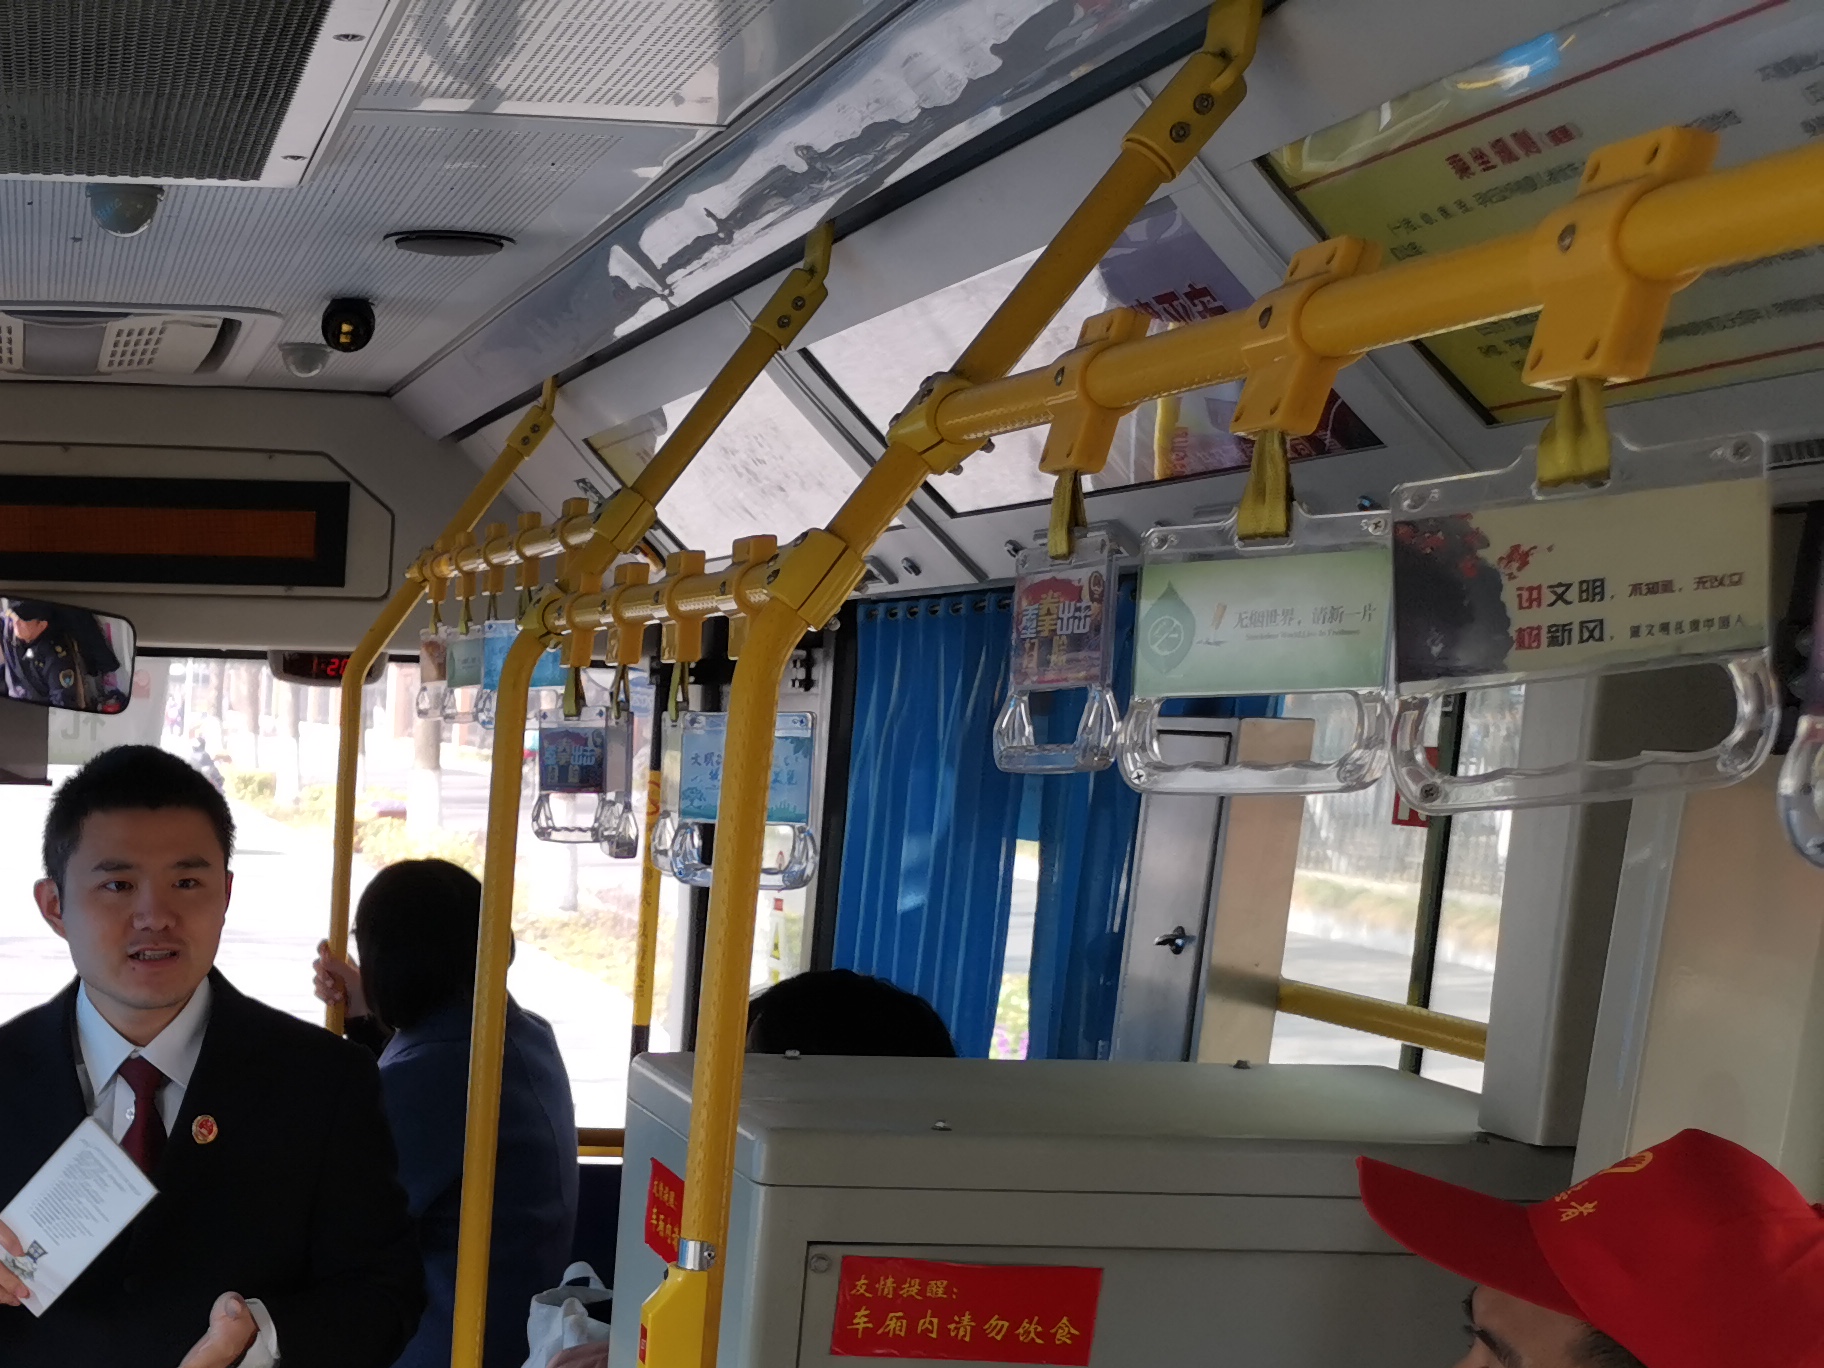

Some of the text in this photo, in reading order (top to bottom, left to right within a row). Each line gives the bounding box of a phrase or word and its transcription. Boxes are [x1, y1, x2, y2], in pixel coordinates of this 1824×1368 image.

[1020, 590, 1092, 639] 重拳出击
[850, 1274, 961, 1301] 友情提醒：
[847, 1307, 1082, 1347] 车厢内请勿饮食
